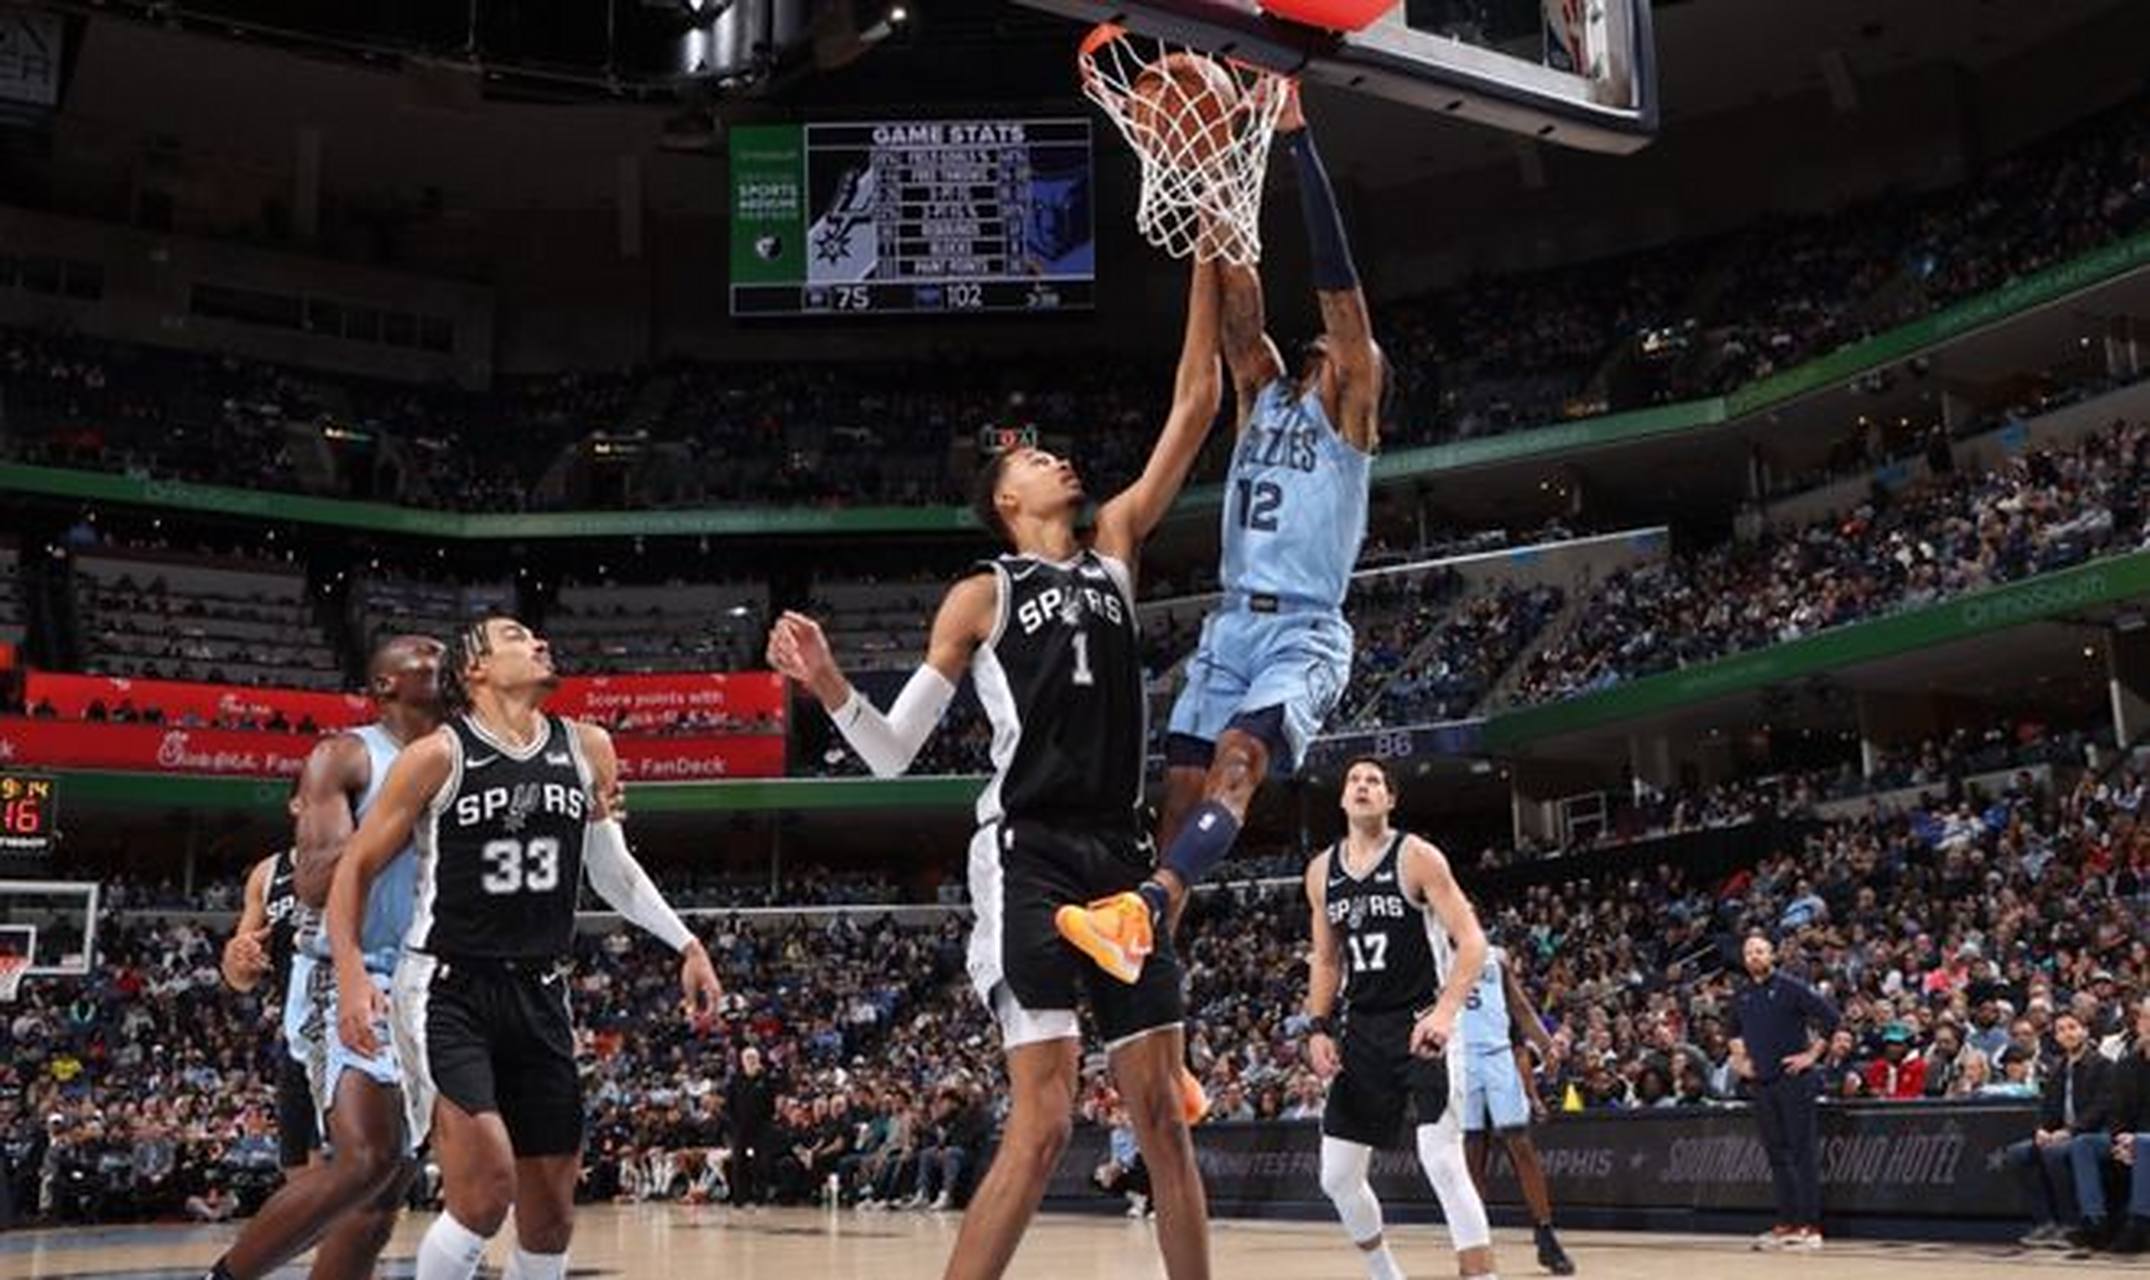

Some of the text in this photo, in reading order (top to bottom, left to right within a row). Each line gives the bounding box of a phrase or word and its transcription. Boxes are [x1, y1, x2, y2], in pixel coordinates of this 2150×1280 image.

[873, 124, 1026, 147] GAME STATS
[738, 184, 797, 199] SPORTS
[836, 286, 870, 311] 75
[946, 284, 983, 308] 102
[1237, 479, 1283, 533] 12
[1018, 586, 1123, 636] SPURS
[1070, 631, 1095, 686] 1
[586, 689, 723, 708] Score points with
[640, 755, 727, 775] FanDeck
[457, 783, 585, 832] SPURS
[482, 837, 560, 894] 33
[1328, 895, 1405, 926] SPURS
[1349, 933, 1389, 972] 17
